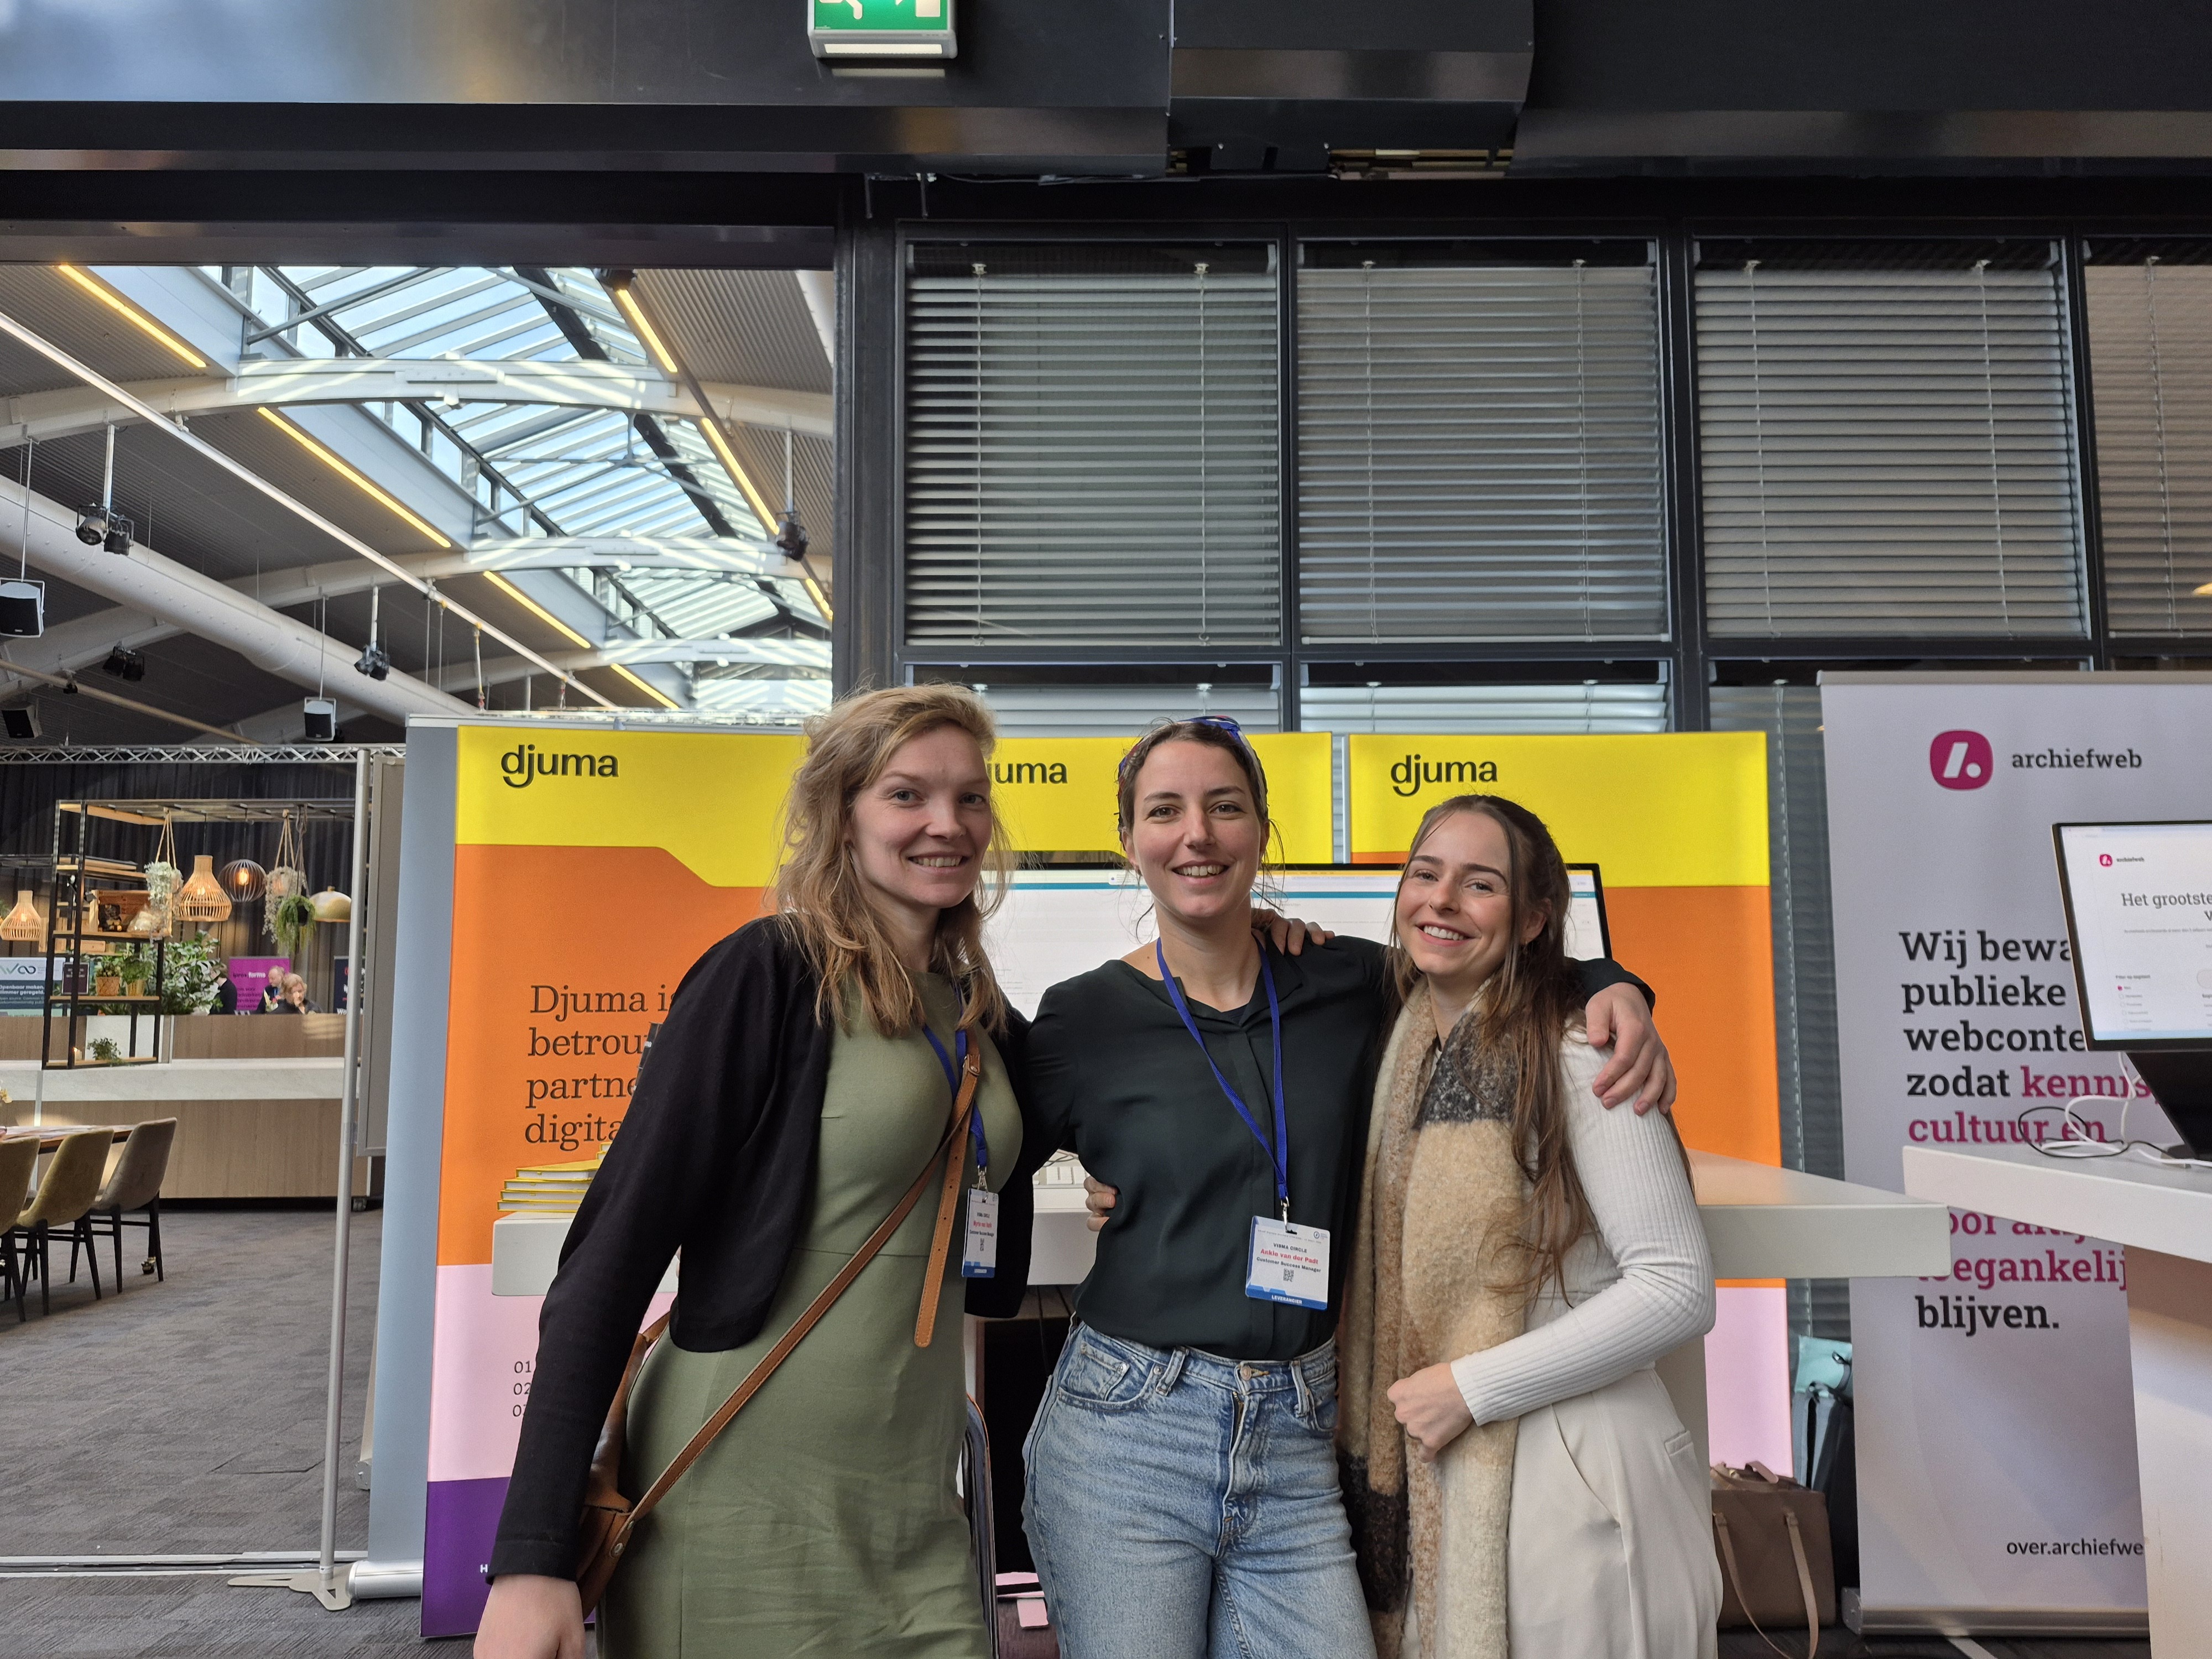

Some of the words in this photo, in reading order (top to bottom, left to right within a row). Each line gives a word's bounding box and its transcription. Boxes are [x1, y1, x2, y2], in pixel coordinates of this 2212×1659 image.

[501, 744, 619, 788] djuma
[2012, 748, 2142, 769] archiefweb
[1391, 754, 1498, 797] djuma
[2121, 893, 2148, 906] Het
[2152, 892, 2212, 909] grootste
[1899, 930, 1967, 969] Wij
[1977, 930, 2071, 961] bewa
[530, 985, 648, 1022] Djuma
[658, 984, 675, 1011] i
[1901, 975, 2067, 1014] publieke
[528, 1027, 647, 1056] betrou
[1903, 1020, 2086, 1051] webconte
[1907, 1066, 2011, 1097] zodat
[1908, 1111, 2049, 1144] cultuur
[2061, 1119, 2109, 1144] en
[1256, 1256, 1279, 1265] Customer
[1301, 1265, 1321, 1273] Manager
[1919, 1250, 2127, 1291] egankelij
[1271, 1295, 1302, 1305] LEVERANCIER
[1915, 1295, 2059, 1337] blijven.
[514, 1361, 531, 1373] 01
[513, 1383, 531, 1395] 02
[2007, 1538, 2144, 1555] over.archiefwe
